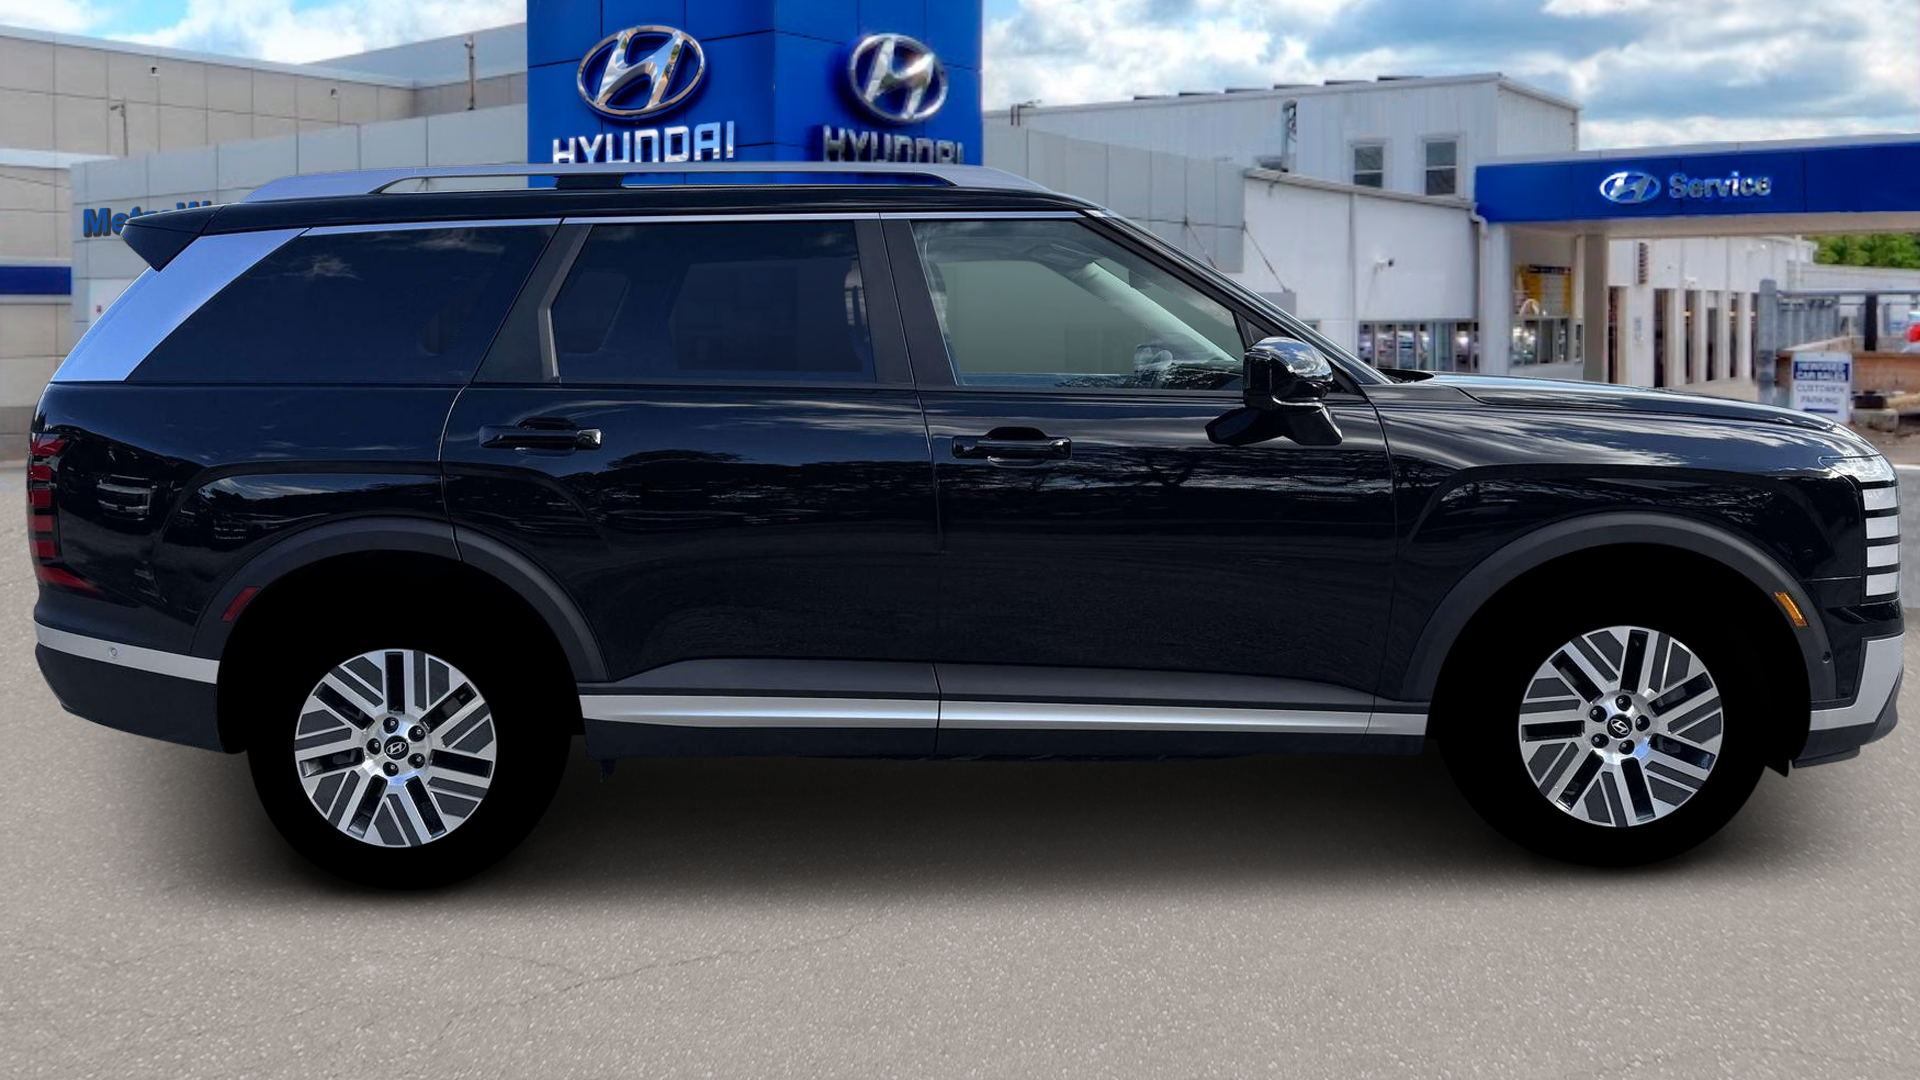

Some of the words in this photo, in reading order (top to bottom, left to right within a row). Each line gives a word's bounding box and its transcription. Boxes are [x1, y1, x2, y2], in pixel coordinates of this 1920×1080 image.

[553, 121, 734, 163] HYUNDAI
[823, 125, 964, 164] HYUNDAI
[1669, 171, 1771, 198] Service
